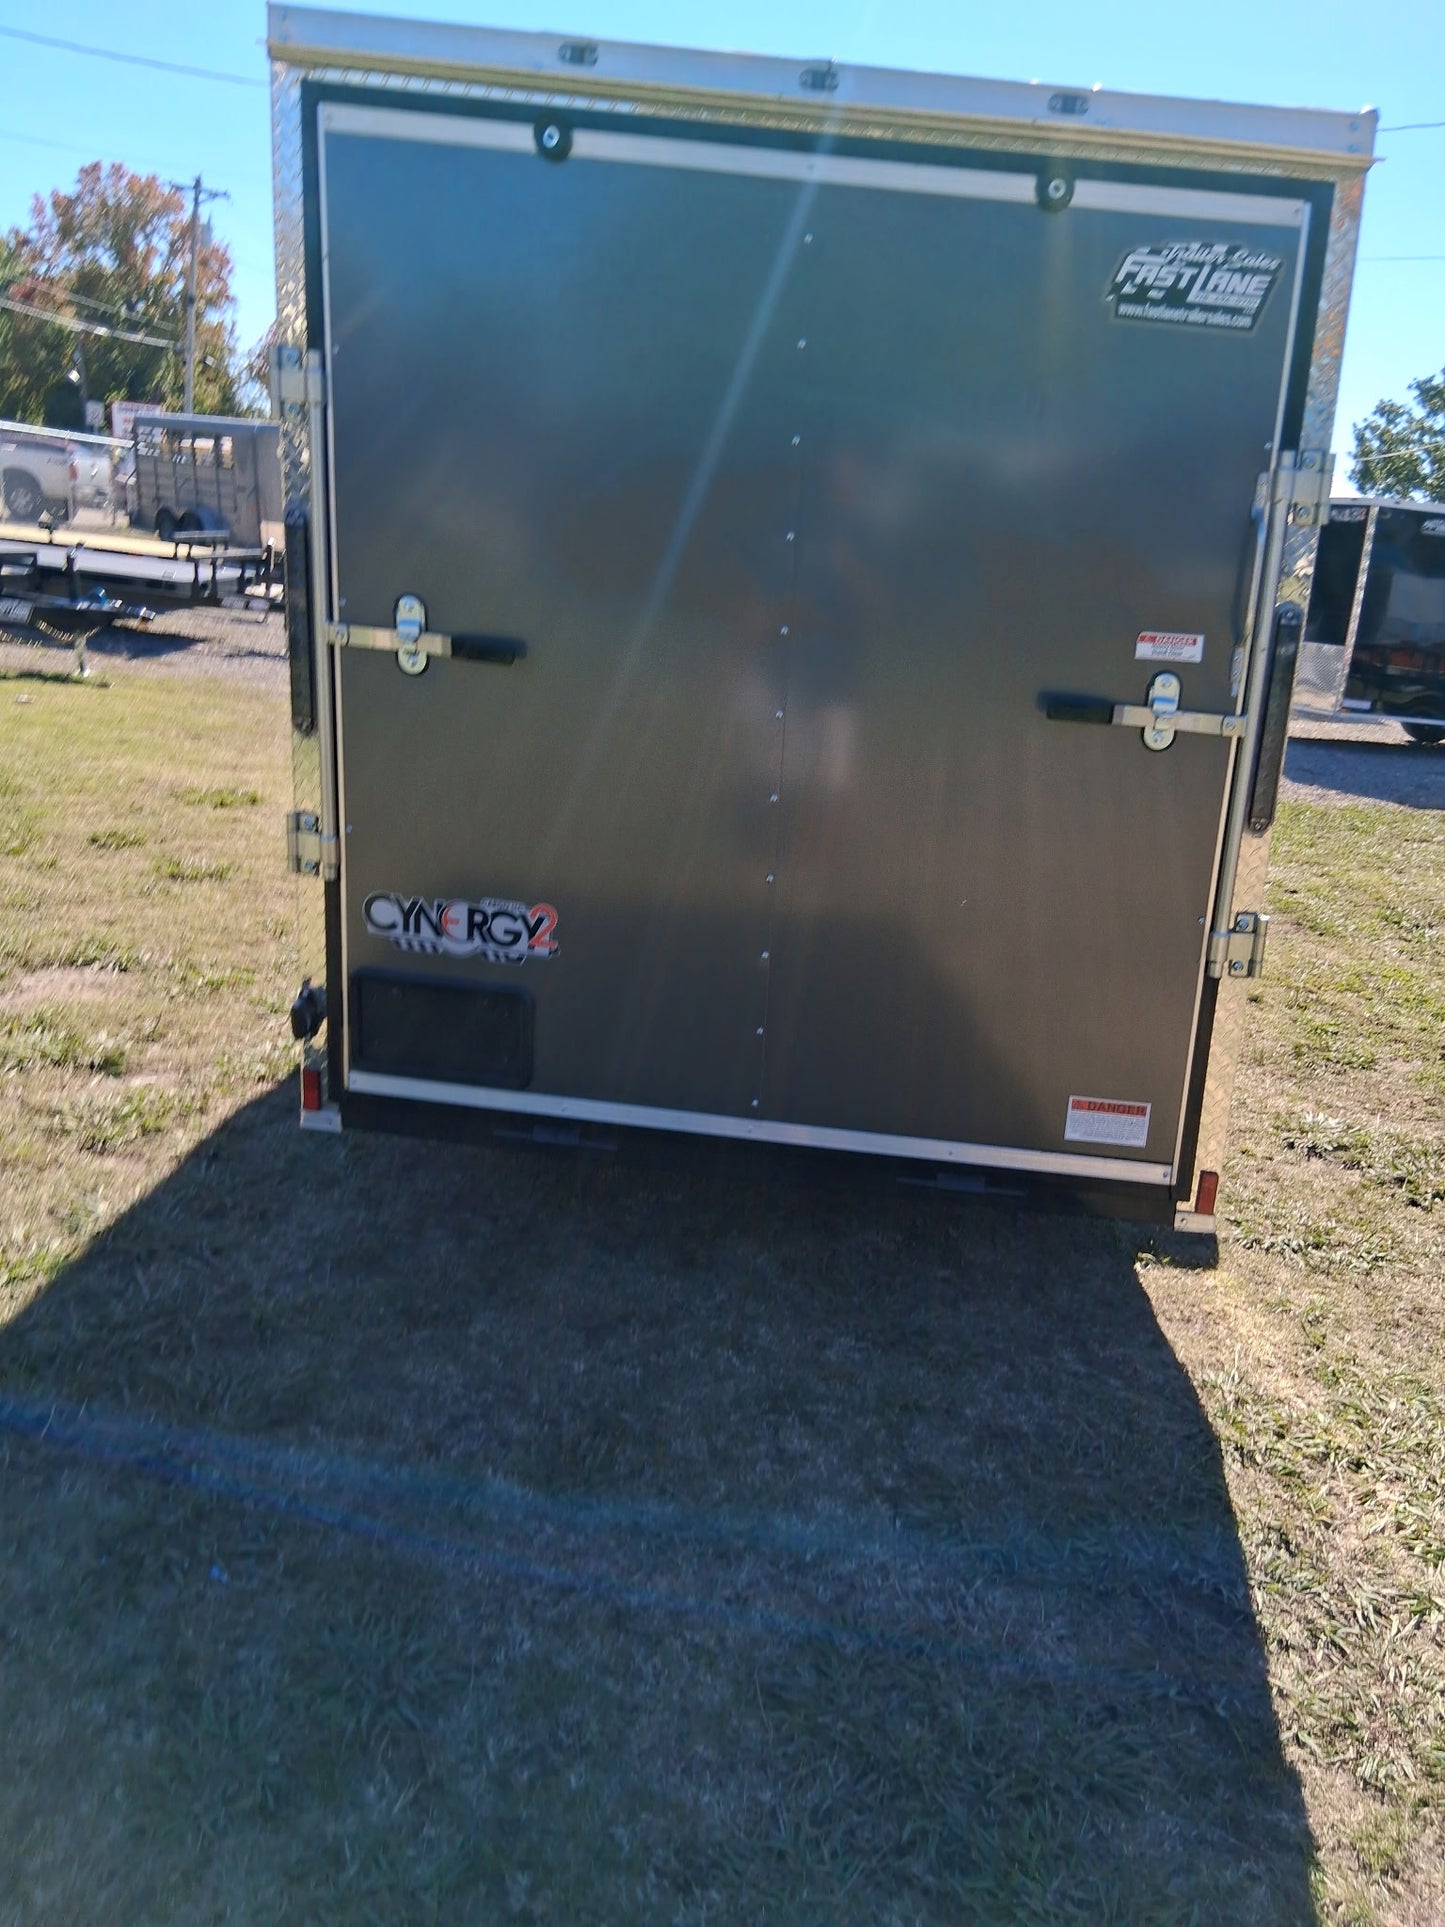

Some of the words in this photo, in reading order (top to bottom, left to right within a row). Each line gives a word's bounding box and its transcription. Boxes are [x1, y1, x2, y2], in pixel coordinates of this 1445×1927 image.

[1221, 249, 1282, 271] Sales
[1115, 254, 1200, 290] FAST
[1186, 263, 1273, 303] LANE
[1087, 1101, 1147, 1117] DANGER
